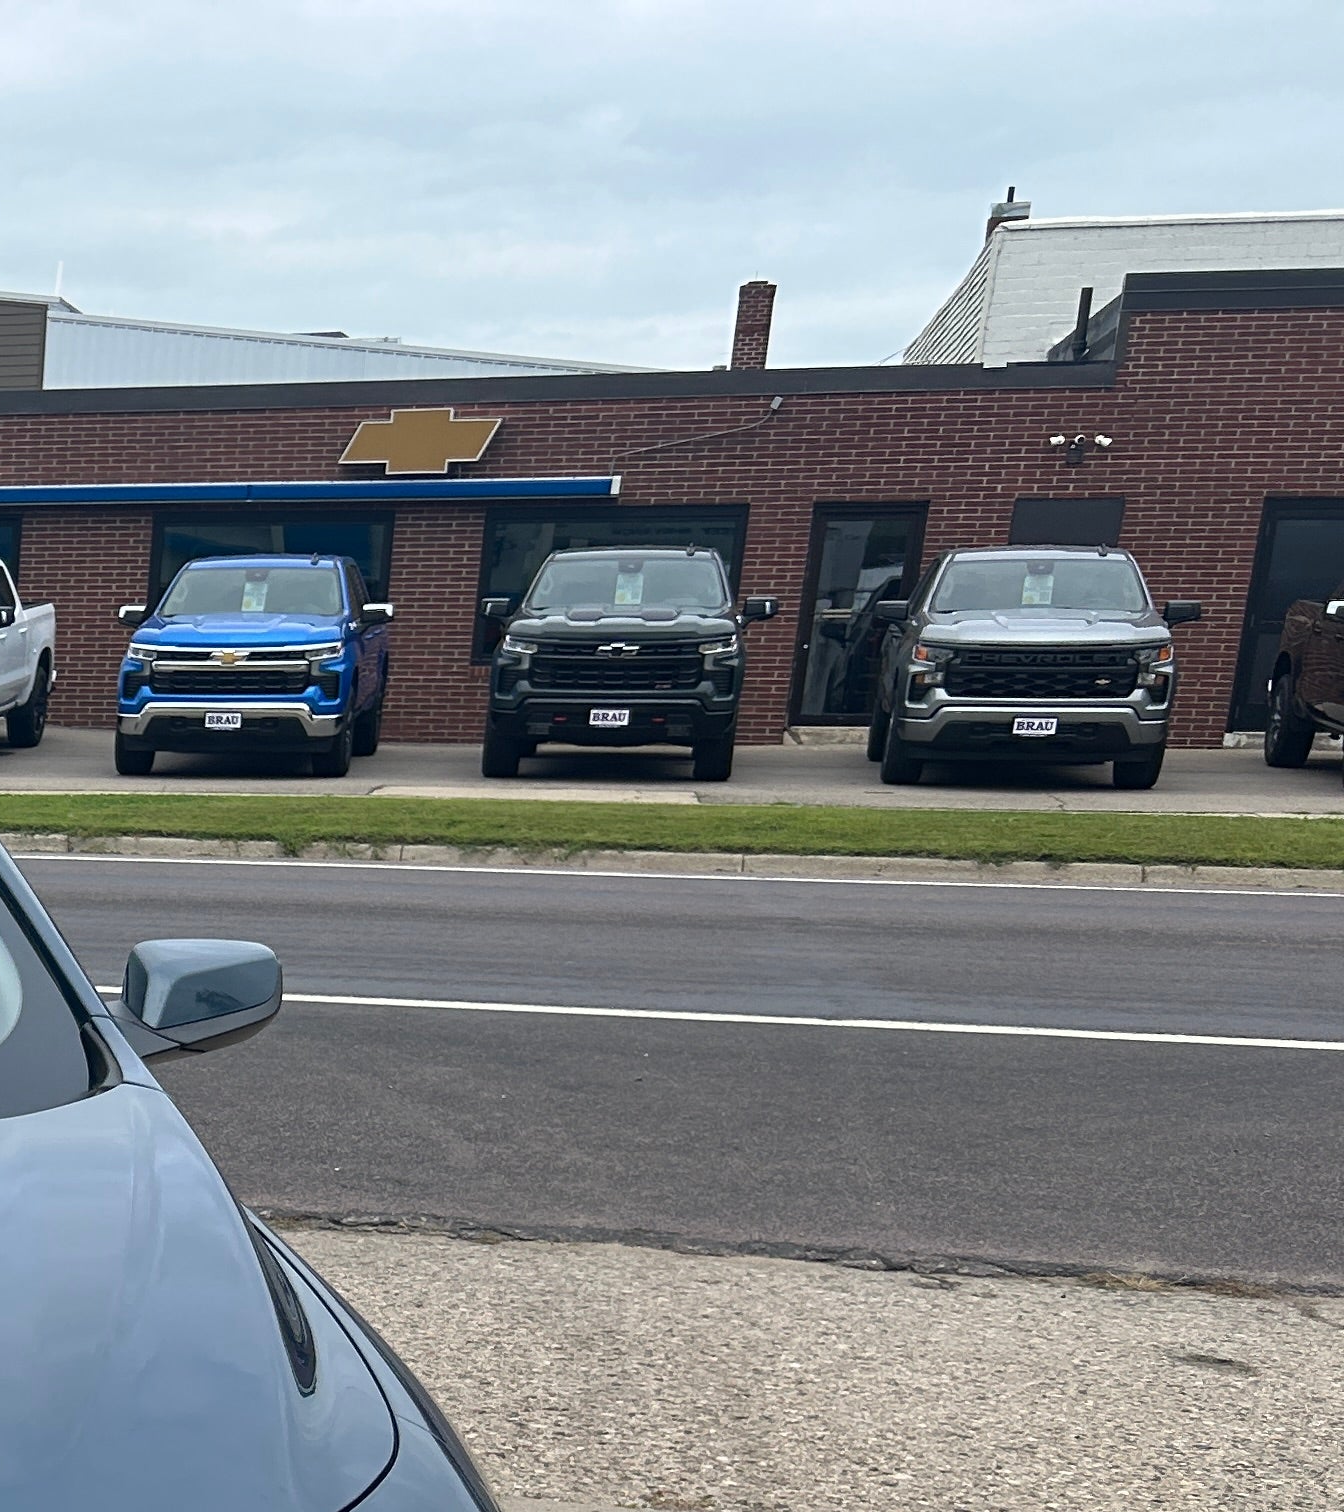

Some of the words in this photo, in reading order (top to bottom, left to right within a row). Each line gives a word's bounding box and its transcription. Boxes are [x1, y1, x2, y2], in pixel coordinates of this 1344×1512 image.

[964, 653, 1129, 666] CHEVROLET
[207, 715, 240, 725] BRAU
[592, 712, 627, 722] BRAU
[1015, 720, 1055, 732] BRAU
